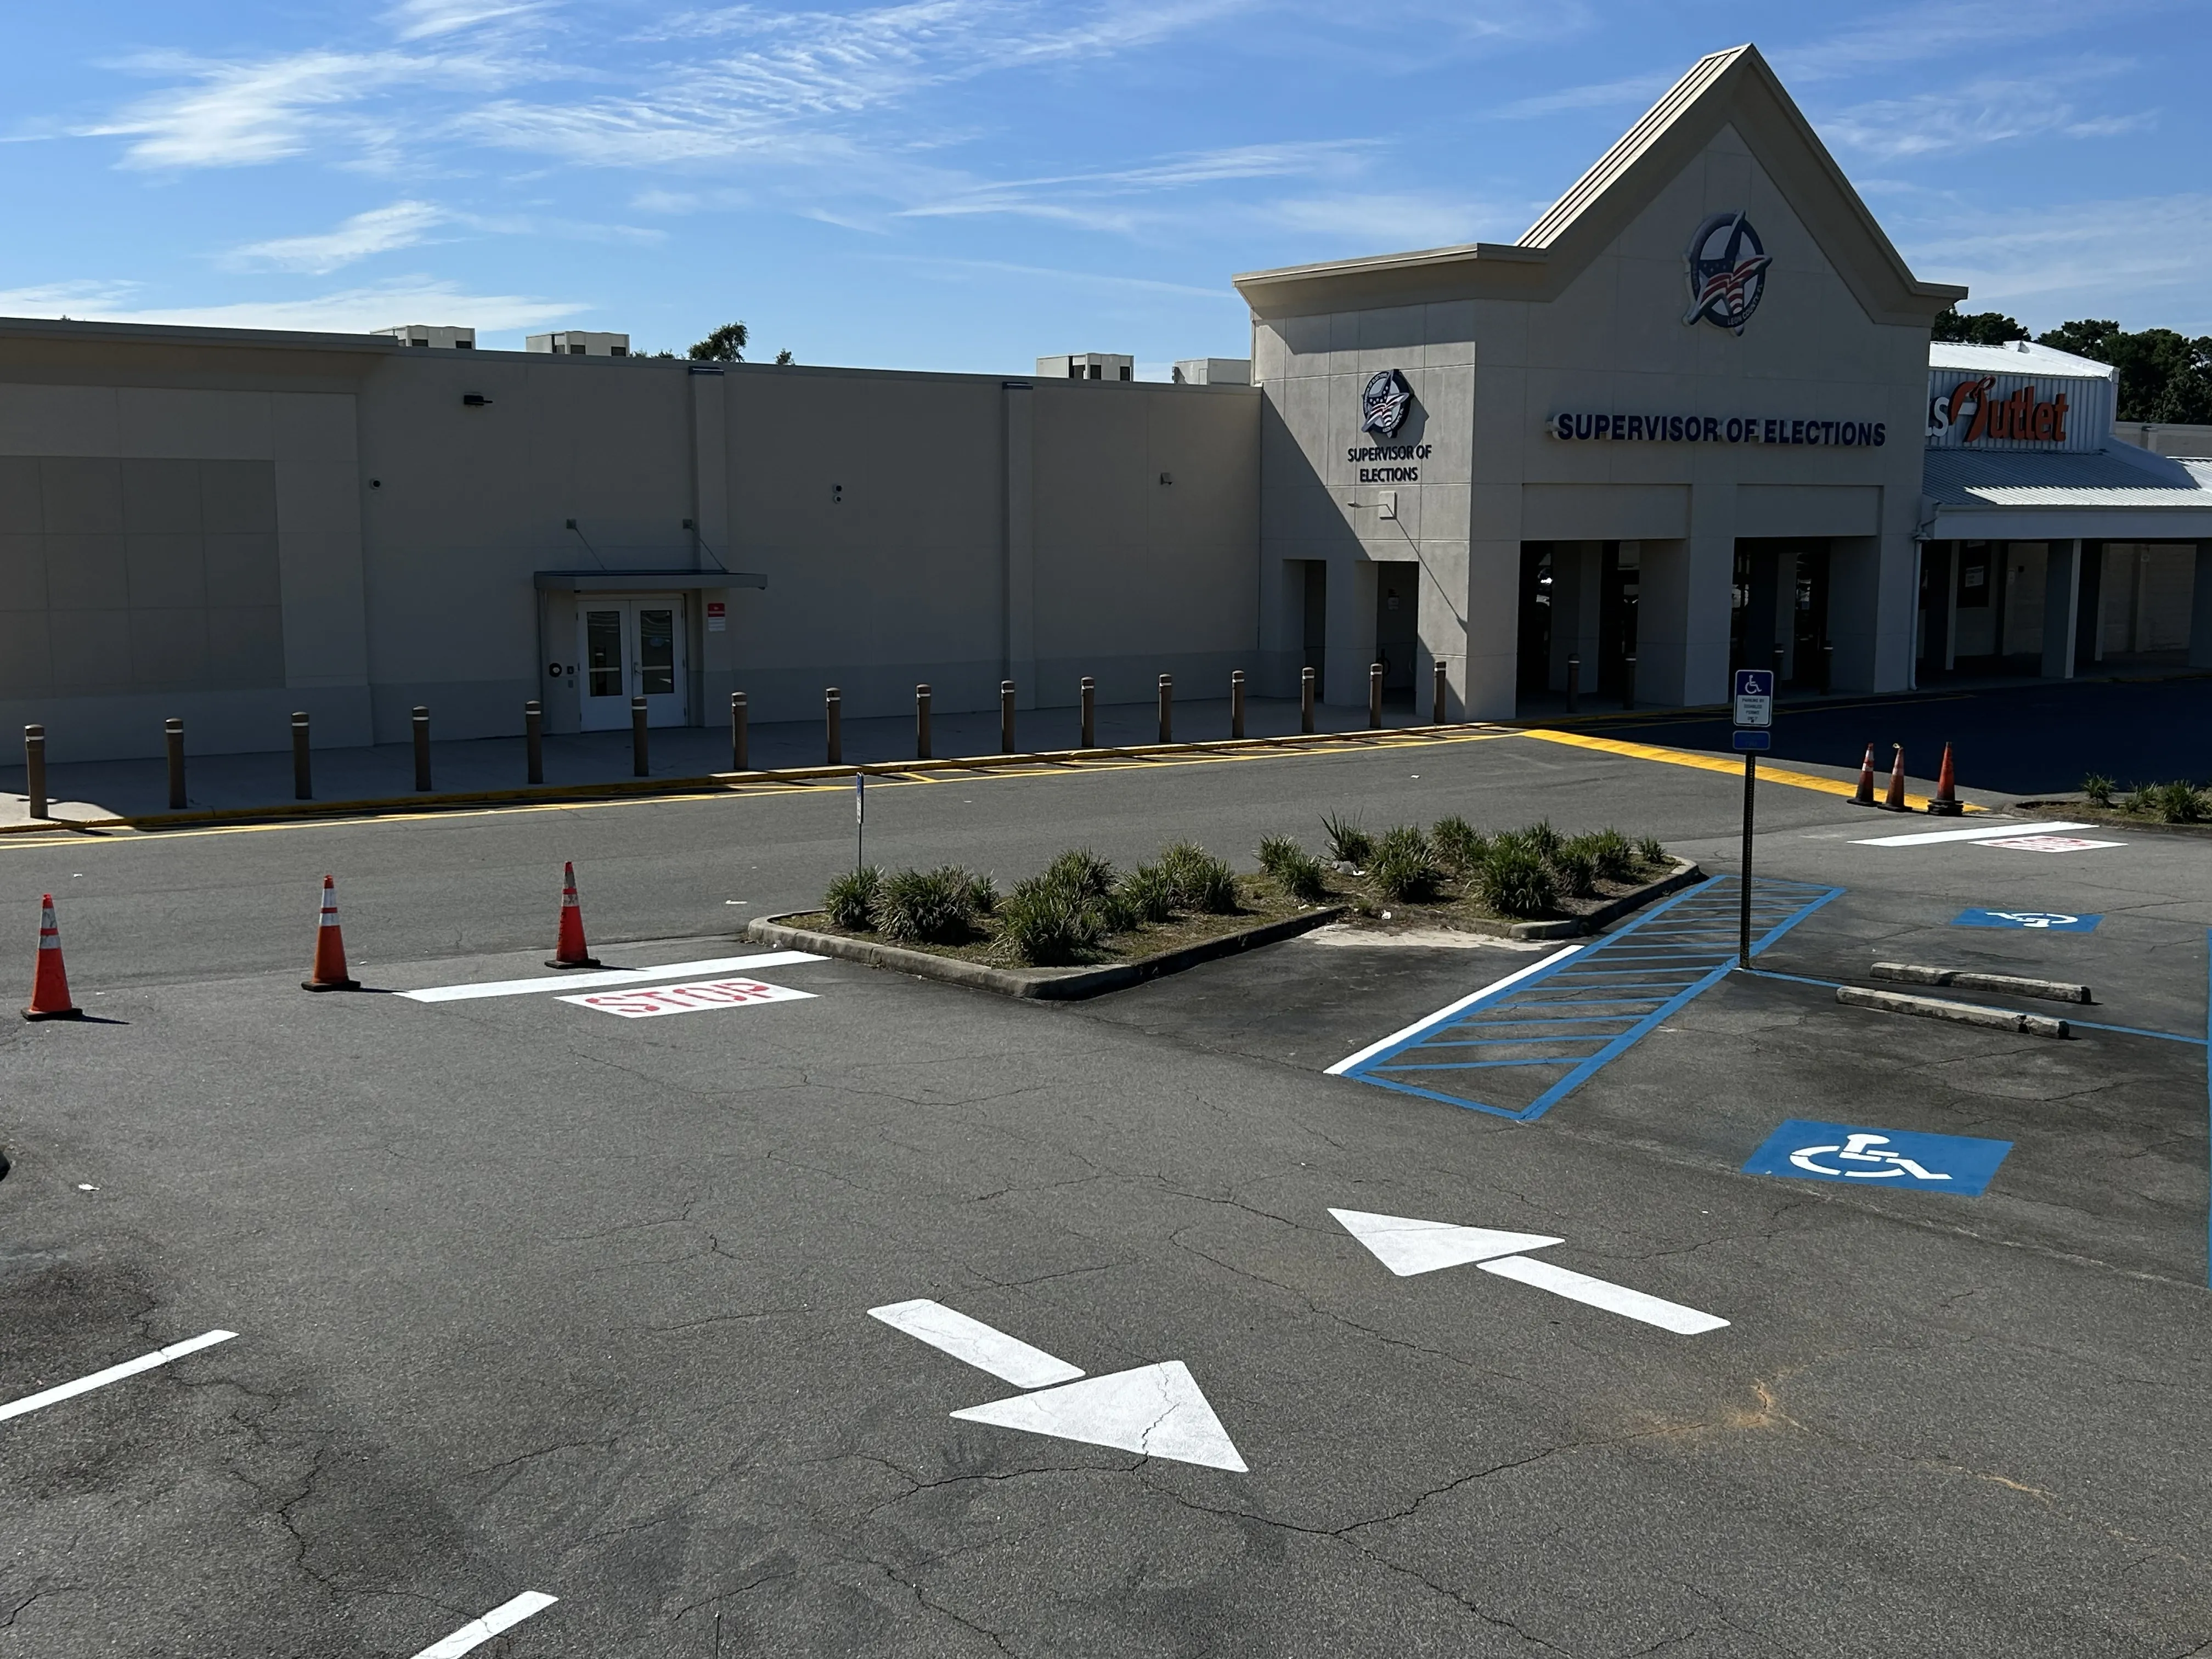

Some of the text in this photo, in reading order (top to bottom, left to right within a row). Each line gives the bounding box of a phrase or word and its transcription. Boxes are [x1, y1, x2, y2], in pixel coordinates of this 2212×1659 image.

[1949, 375, 2069, 443] Outlet
[1556, 413, 1886, 447] SUPERVISOR OF ELECTIONS
[1347, 444, 1432, 462] SUPERVISOR OF
[1359, 467, 1418, 483] ELECTIONS
[585, 983, 774, 1013] STOP
